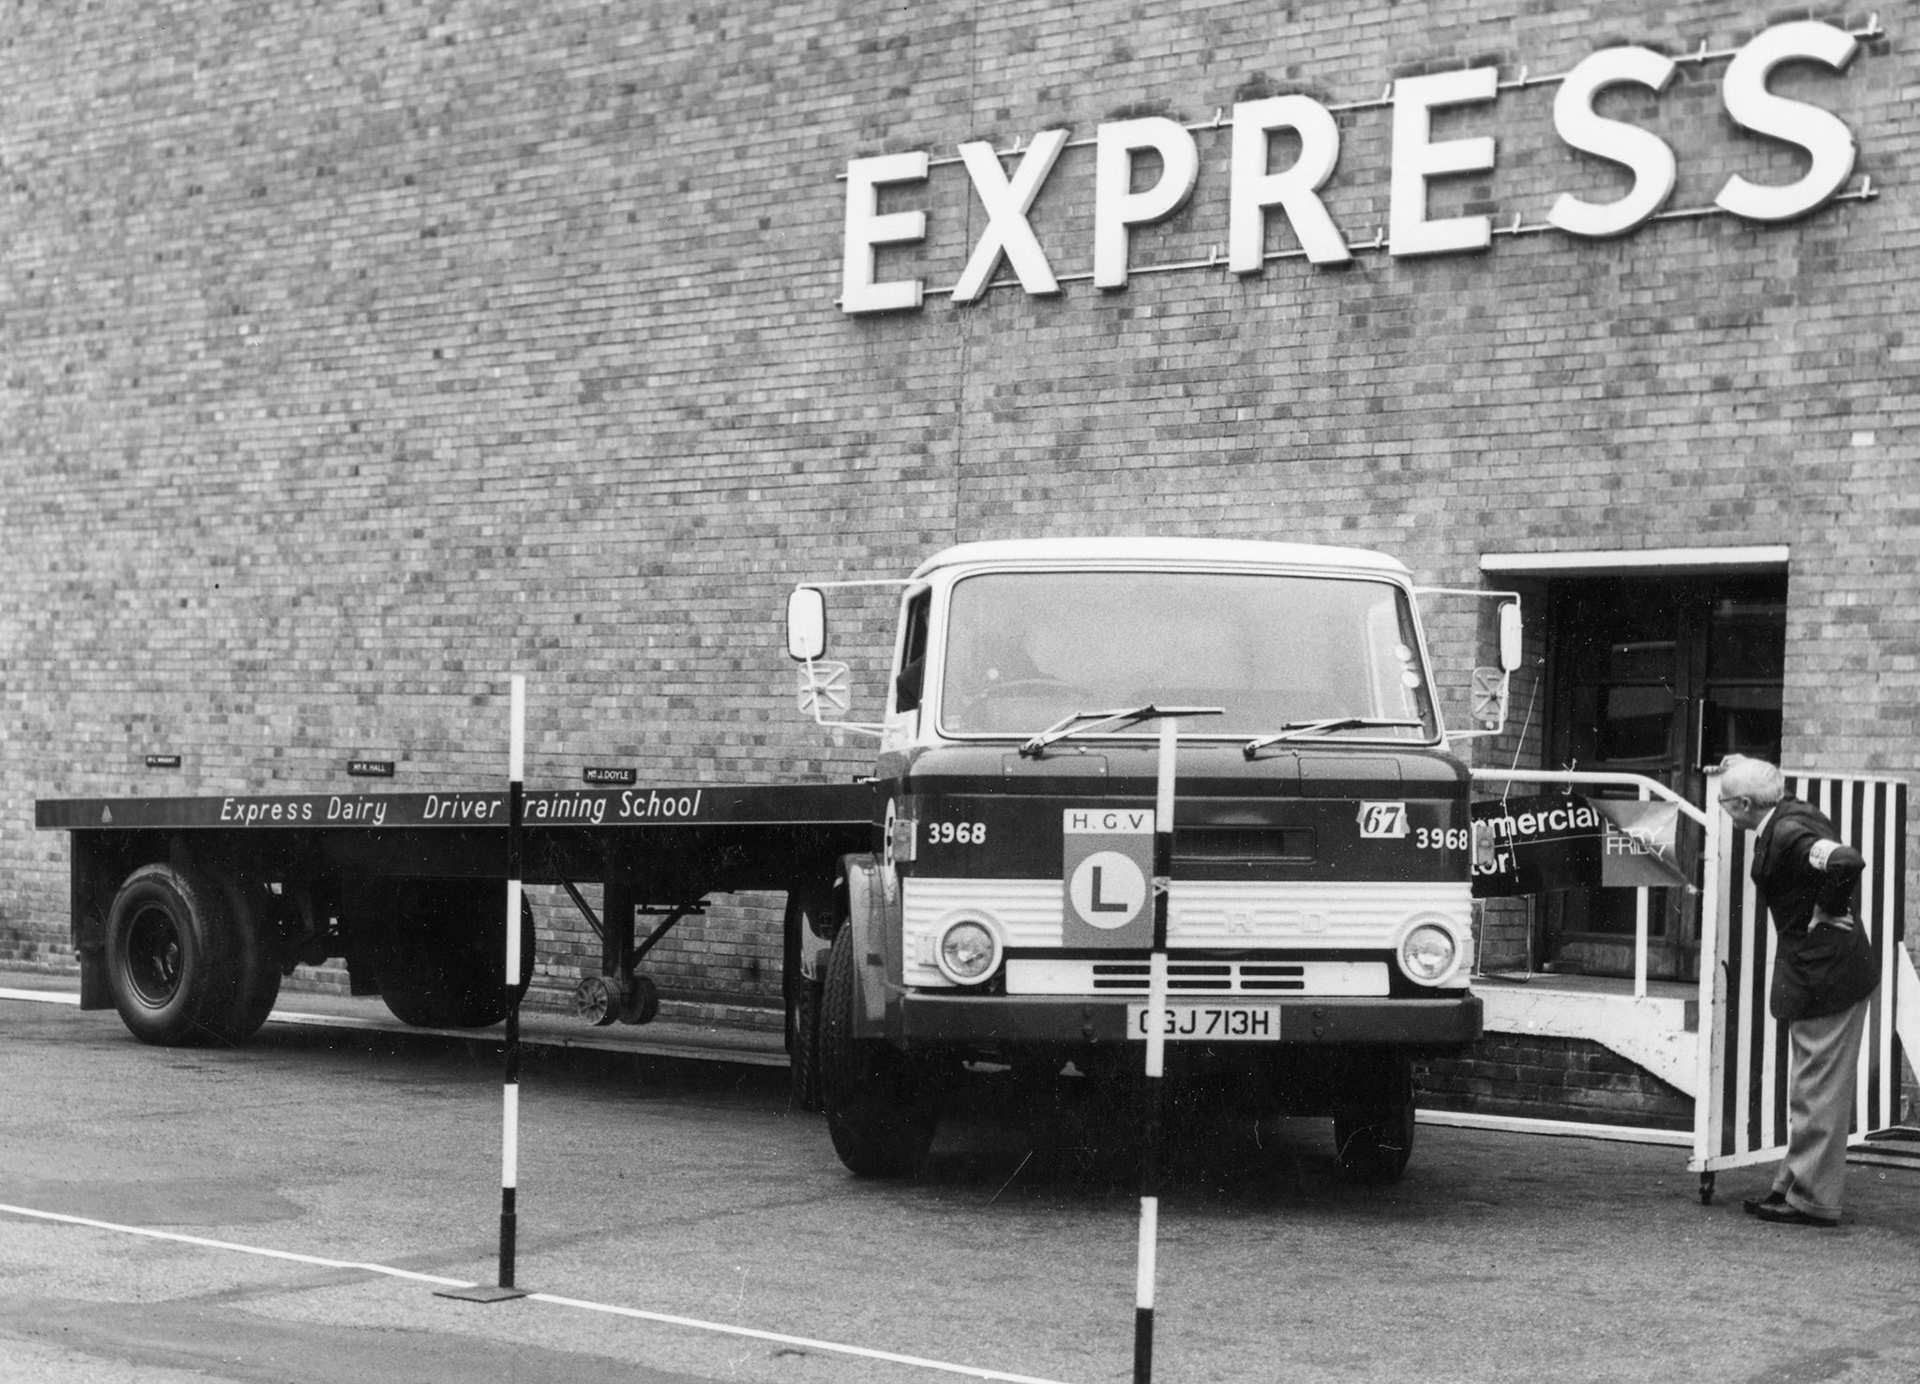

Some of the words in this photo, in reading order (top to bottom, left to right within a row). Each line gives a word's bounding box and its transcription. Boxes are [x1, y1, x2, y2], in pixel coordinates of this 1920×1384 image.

[841, 20, 1857, 313] EXPRESS
[220, 797, 313, 826] Express
[327, 796, 387, 826] Dairy
[423, 794, 502, 819] Driver
[521, 792, 606, 825] raining
[619, 790, 702, 818] School
[1363, 805, 1401, 834] 67
[928, 821, 987, 845] 3968
[1416, 827, 1468, 850] 3968
[1091, 866, 1128, 912] L
[1205, 1010, 1269, 1035] 713H
